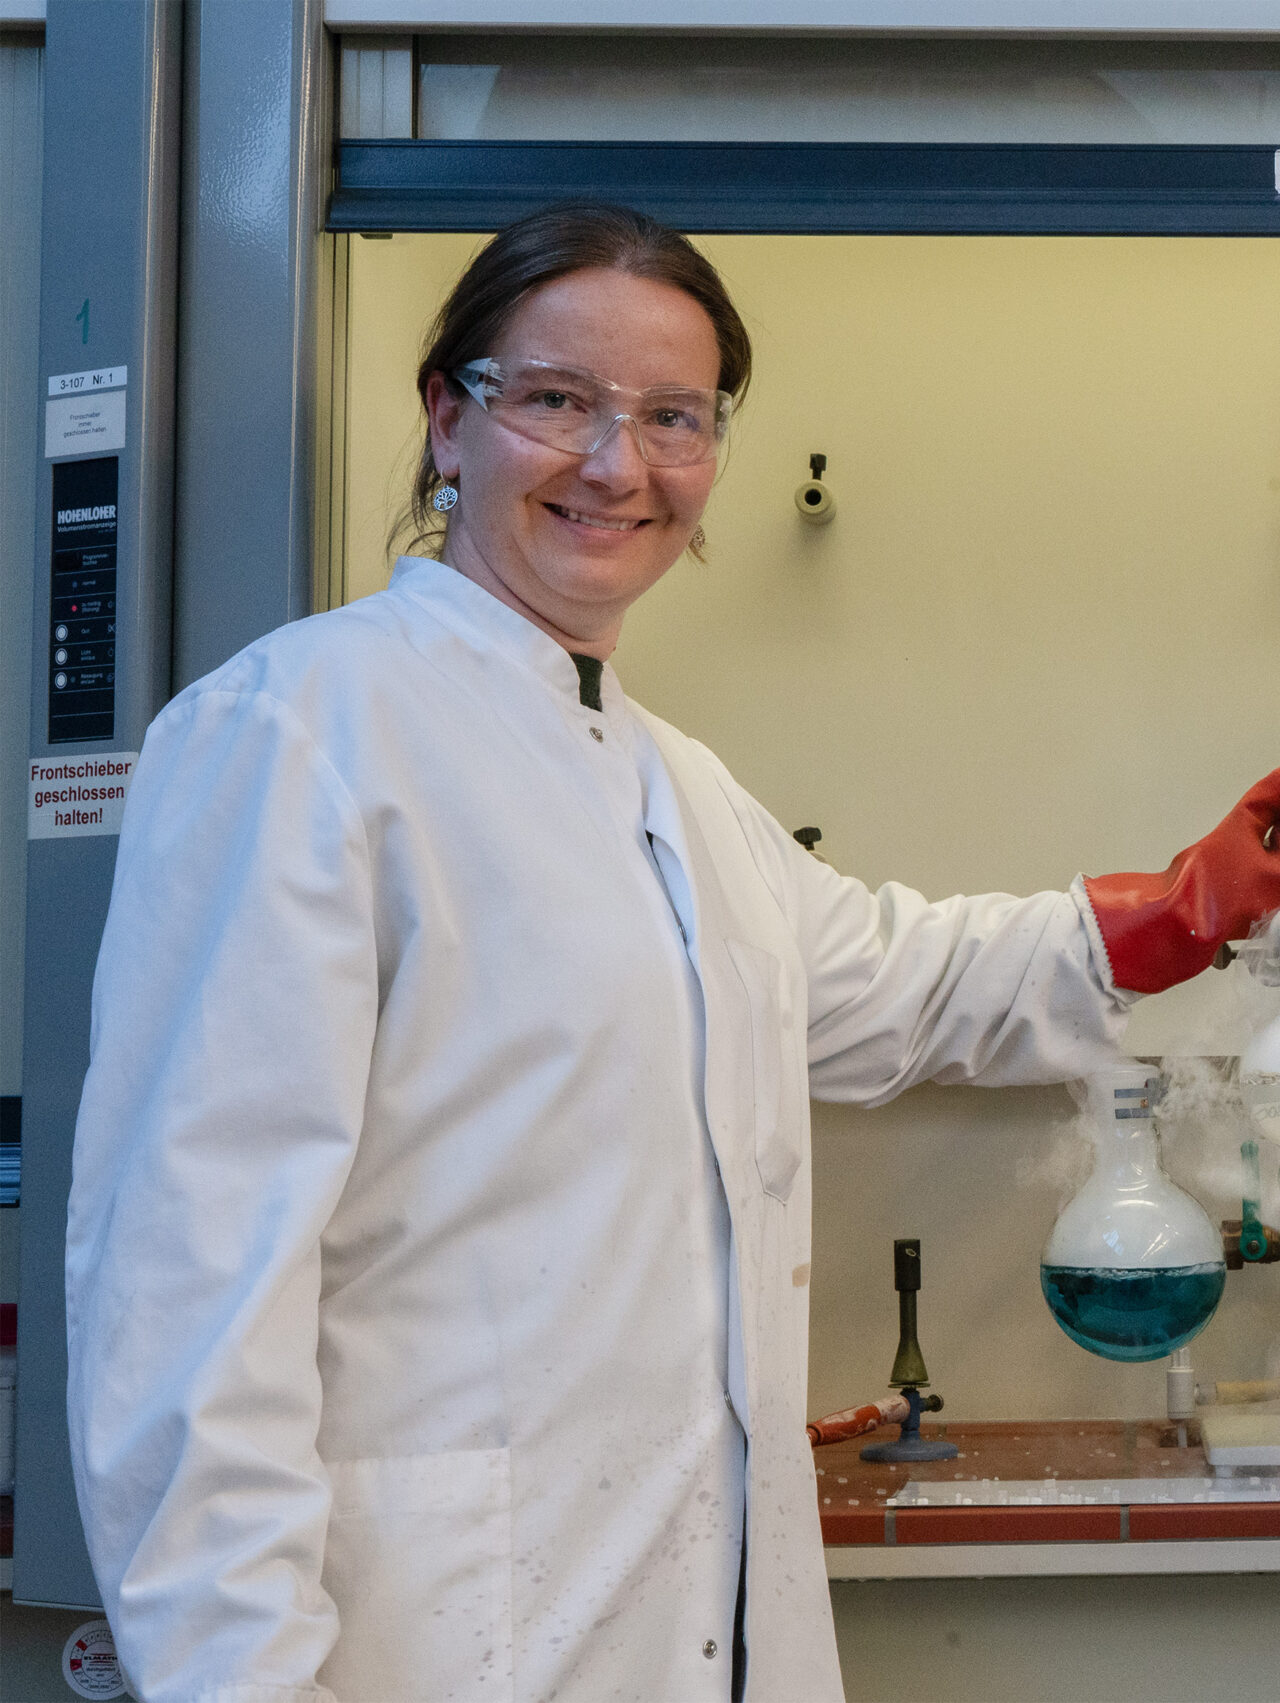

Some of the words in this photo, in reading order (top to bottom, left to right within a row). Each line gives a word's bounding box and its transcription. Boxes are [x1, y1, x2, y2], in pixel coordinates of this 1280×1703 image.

[75, 297, 90, 344] 1
[60, 377, 85, 390] 3-107
[92, 374, 105, 385] Nr.
[109, 373, 113, 382] 1
[57, 504, 116, 525] HOHENLOHER
[57, 521, 116, 532] Volumenstromanzeige
[31, 760, 132, 781] Frontschieber
[34, 785, 125, 808] geschlossen
[55, 807, 103, 826] halten!
